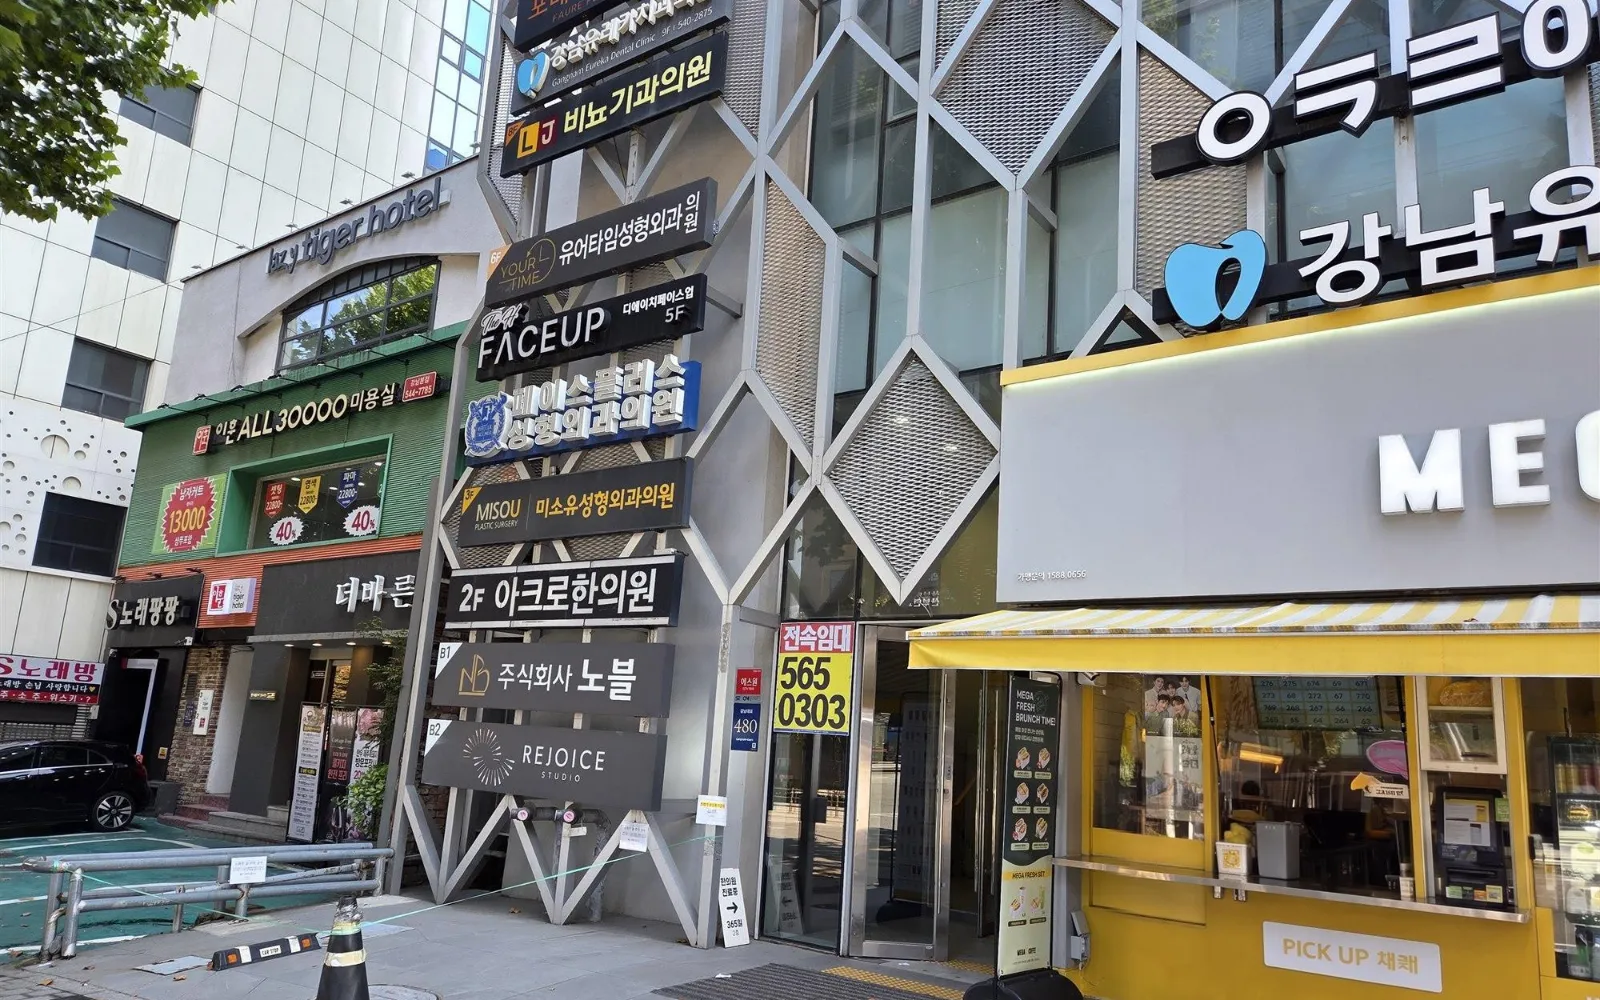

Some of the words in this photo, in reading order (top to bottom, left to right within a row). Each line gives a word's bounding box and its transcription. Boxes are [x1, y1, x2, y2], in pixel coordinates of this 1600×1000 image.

[551, 67, 585, 87] Gangnam
[585, 55, 609, 72] Eureka
[611, 41, 634, 59] Dental
[636, 33, 656, 48] Clinic
[661, 26, 671, 37] 9F
[677, 7, 713, 30] 540-2875
[564, 51, 713, 134] 비뇨기과의원
[302, 217, 364, 265] tiger
[366, 177, 442, 238] hotel
[558, 203, 684, 267] 유어타임성형외과
[490, 251, 502, 263] 6F
[501, 257, 537, 279] YOUR
[510, 270, 542, 292] TIME
[622, 285, 695, 315] 디에이치페이스업
[664, 304, 686, 324] 5F
[350, 382, 396, 412] 미용실
[512, 353, 687, 418] 페이스플러스
[508, 388, 685, 450] 성형외과의원
[475, 498, 522, 522] MISOU
[535, 482, 676, 519] 미소유성형외과의원
[169, 506, 206, 534] 13000
[276, 521, 296, 541] 40%
[351, 510, 376, 532] 40%
[475, 521, 494, 531] PLASTIC
[494, 519, 519, 530] SURGERY
[232, 593, 245, 602] tiger
[458, 583, 486, 612] 2F
[494, 568, 658, 617] 아크로한의원
[106, 595, 180, 630] S노래팡팡
[231, 602, 244, 610] hotel
[784, 624, 852, 652] 전속임대
[440, 647, 451, 660] B1
[497, 662, 573, 693] 주식회사
[577, 658, 637, 701] 노블
[780, 656, 832, 691] 565
[46, 682, 88, 693] 사랑합니다
[1016, 689, 1034, 701] MEGA
[778, 692, 846, 730] 0303
[1015, 712, 1041, 724] BRUNCH
[1016, 701, 1036, 712] FRESH
[429, 723, 441, 736] B2
[734, 718, 758, 734] 480
[522, 744, 606, 771] REJOICE
[541, 770, 581, 783] STUDIO
[1282, 938, 1333, 962] PICK
[1338, 945, 1370, 966] UP
